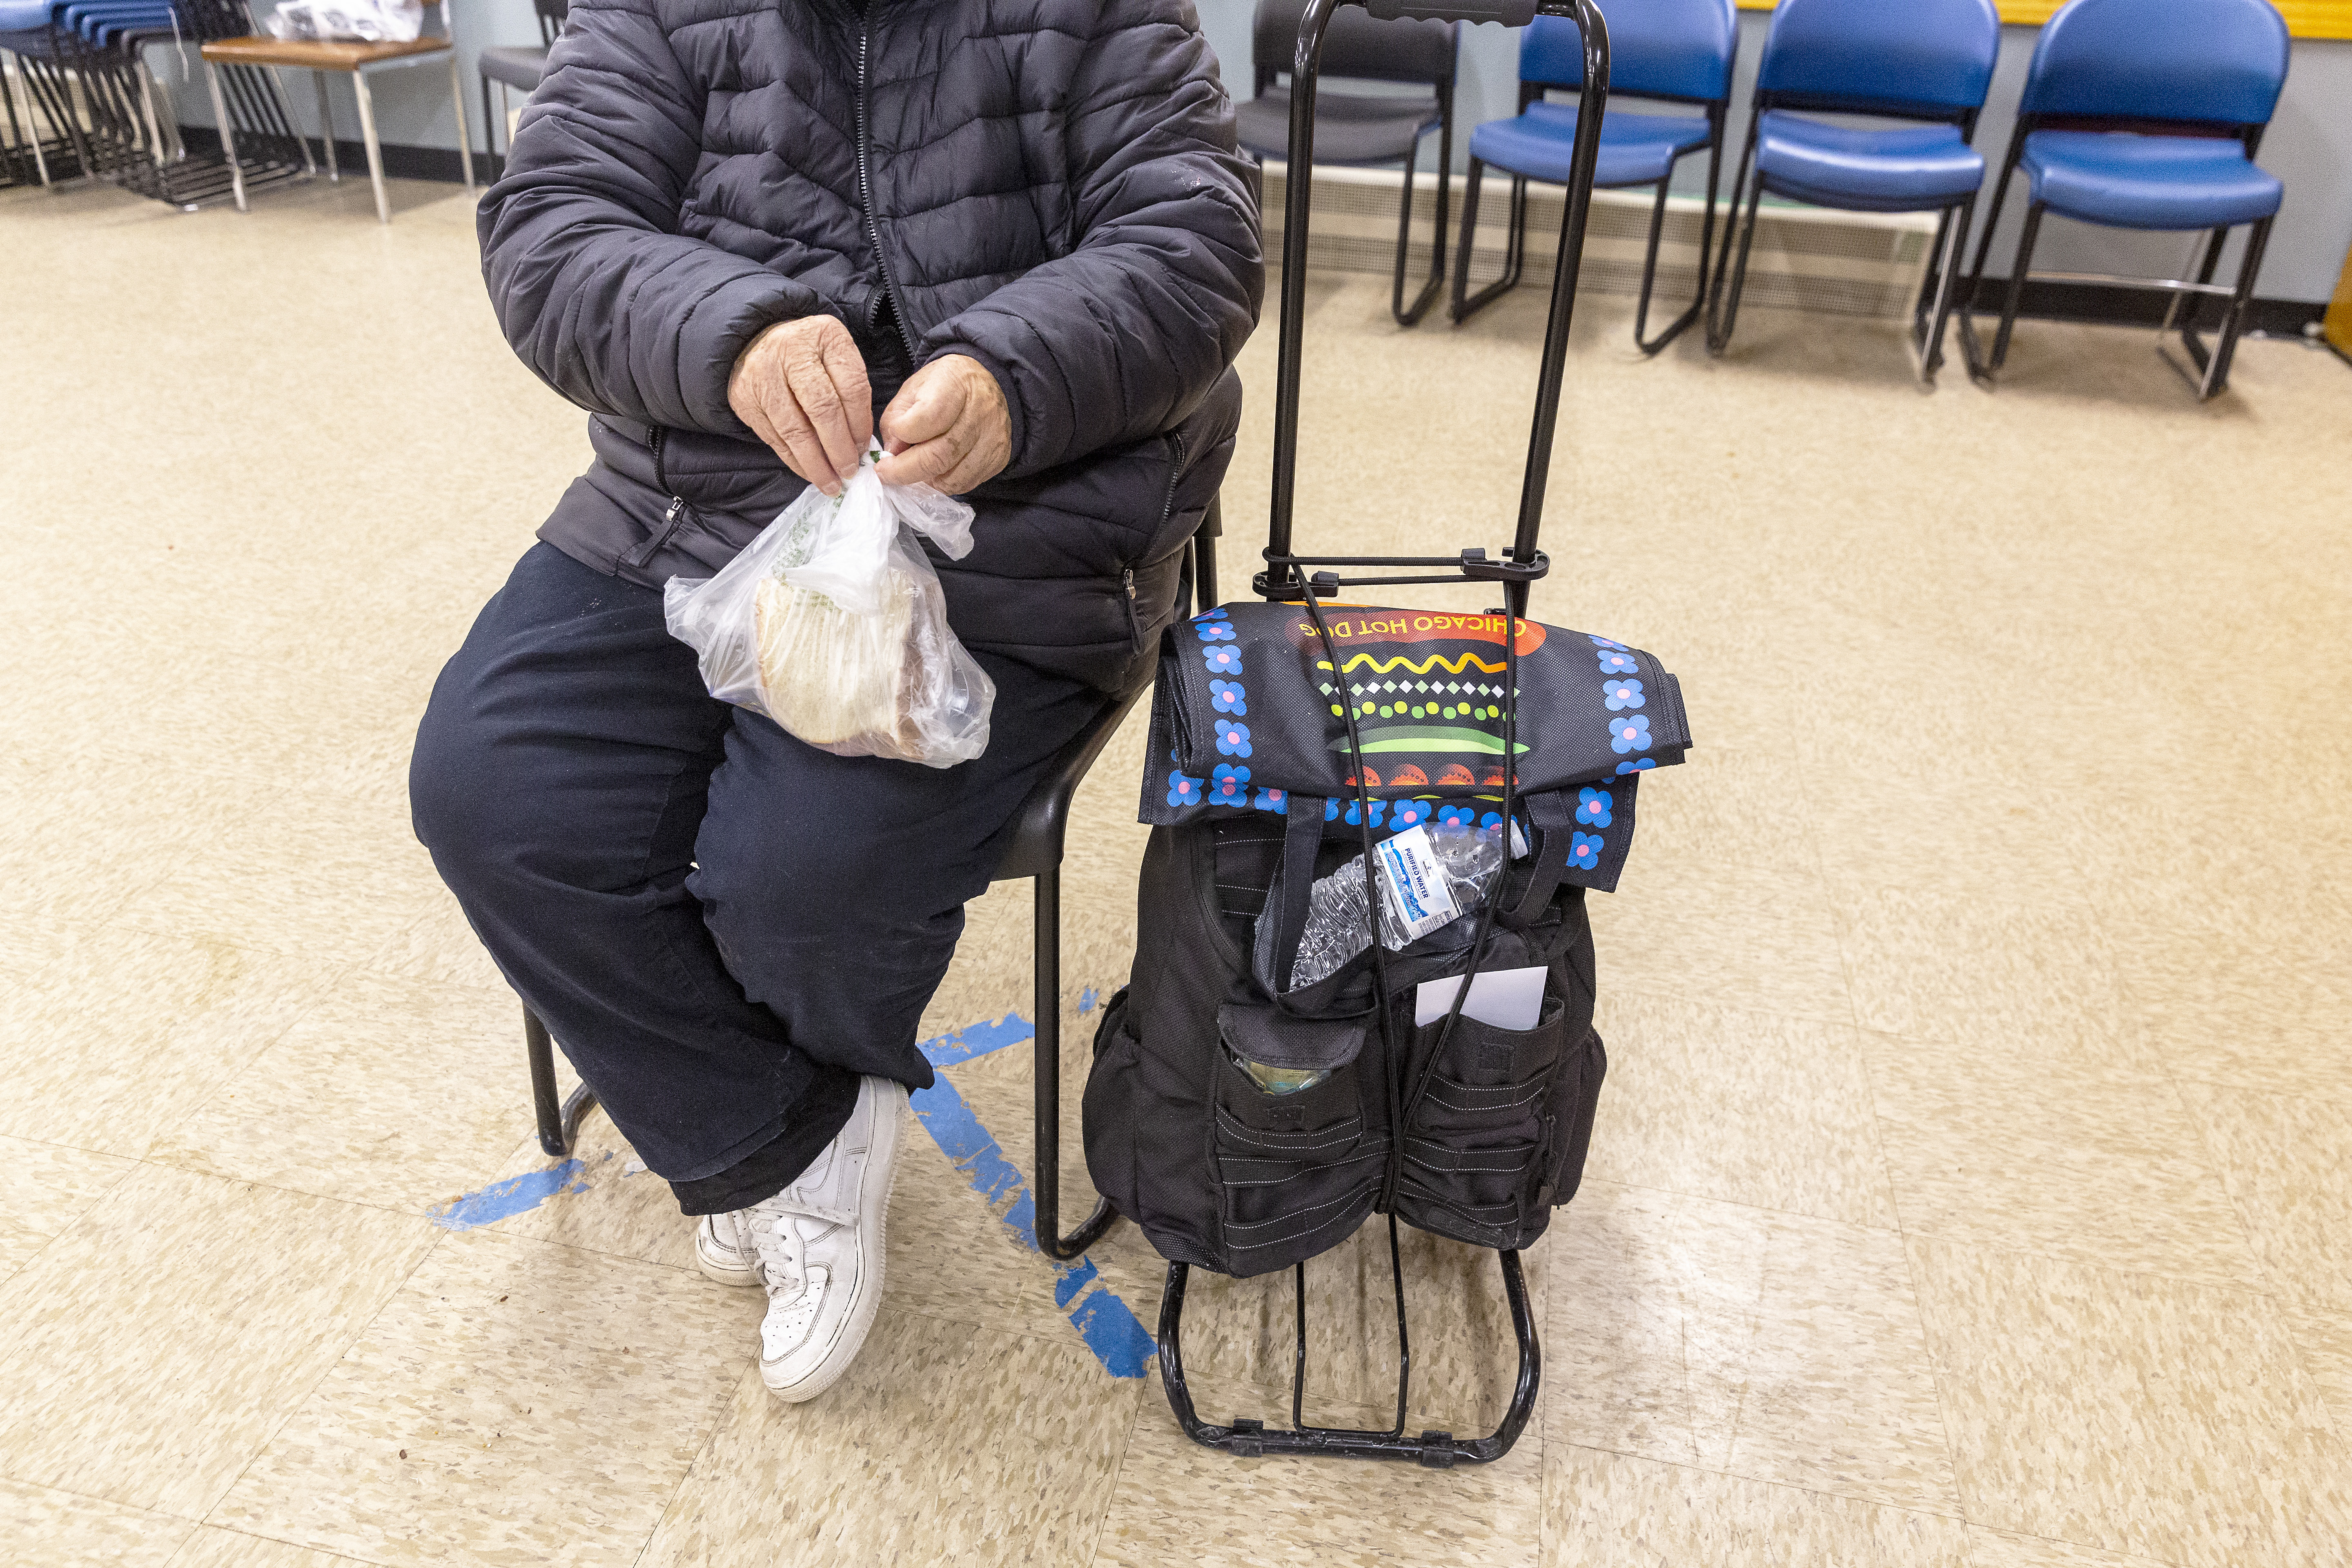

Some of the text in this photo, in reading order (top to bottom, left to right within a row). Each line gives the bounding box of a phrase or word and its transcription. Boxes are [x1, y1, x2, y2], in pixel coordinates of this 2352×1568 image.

[1358, 619, 1408, 635] HOT
[1414, 616, 1526, 637] CHICAGO
[1405, 848, 1419, 876] PURIFIED
[1416, 876, 1428, 899] WATER
